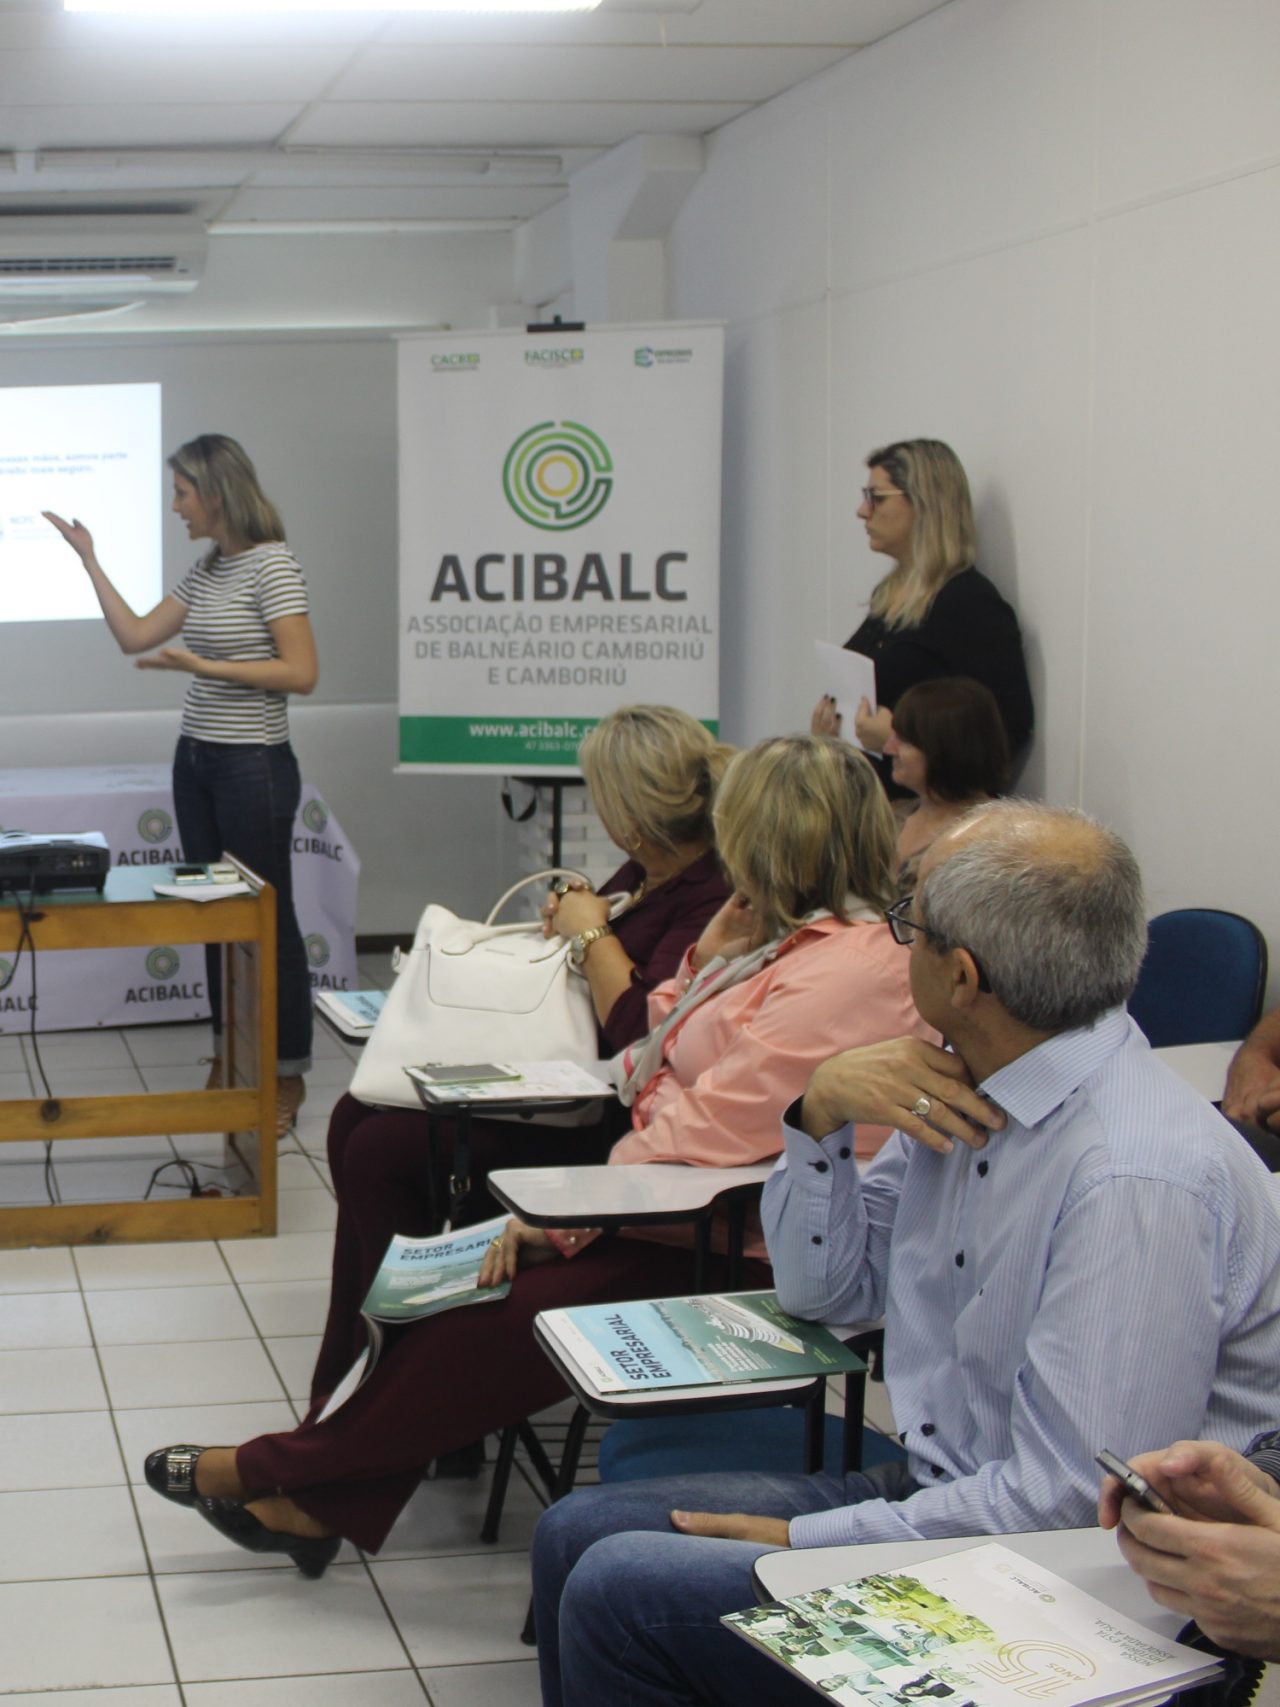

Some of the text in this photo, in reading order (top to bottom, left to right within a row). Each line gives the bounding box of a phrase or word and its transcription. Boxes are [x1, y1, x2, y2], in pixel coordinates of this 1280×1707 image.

[429, 552, 689, 603] ACIBALC
[406, 611, 713, 638] ASSOCIAÇÃO EMPRESARIAL
[414, 637, 705, 662] DE BALNEÁRIO CAMBORIÚ
[487, 662, 628, 687] E CAMBORIÚ
[116, 848, 187, 867] ACIBAL
[292, 837, 344, 862] CIBALC
[124, 982, 205, 1004] ACIBALC
[399, 1236, 501, 1261] EMPRESARI
[403, 1242, 454, 1256] SETOR
[604, 1313, 672, 1380] EMPRESARIAL
[610, 1350, 650, 1381] SETOR
[1119, 1650, 1154, 1667] NOSSA
[1045, 1662, 1086, 1682] ANOS
